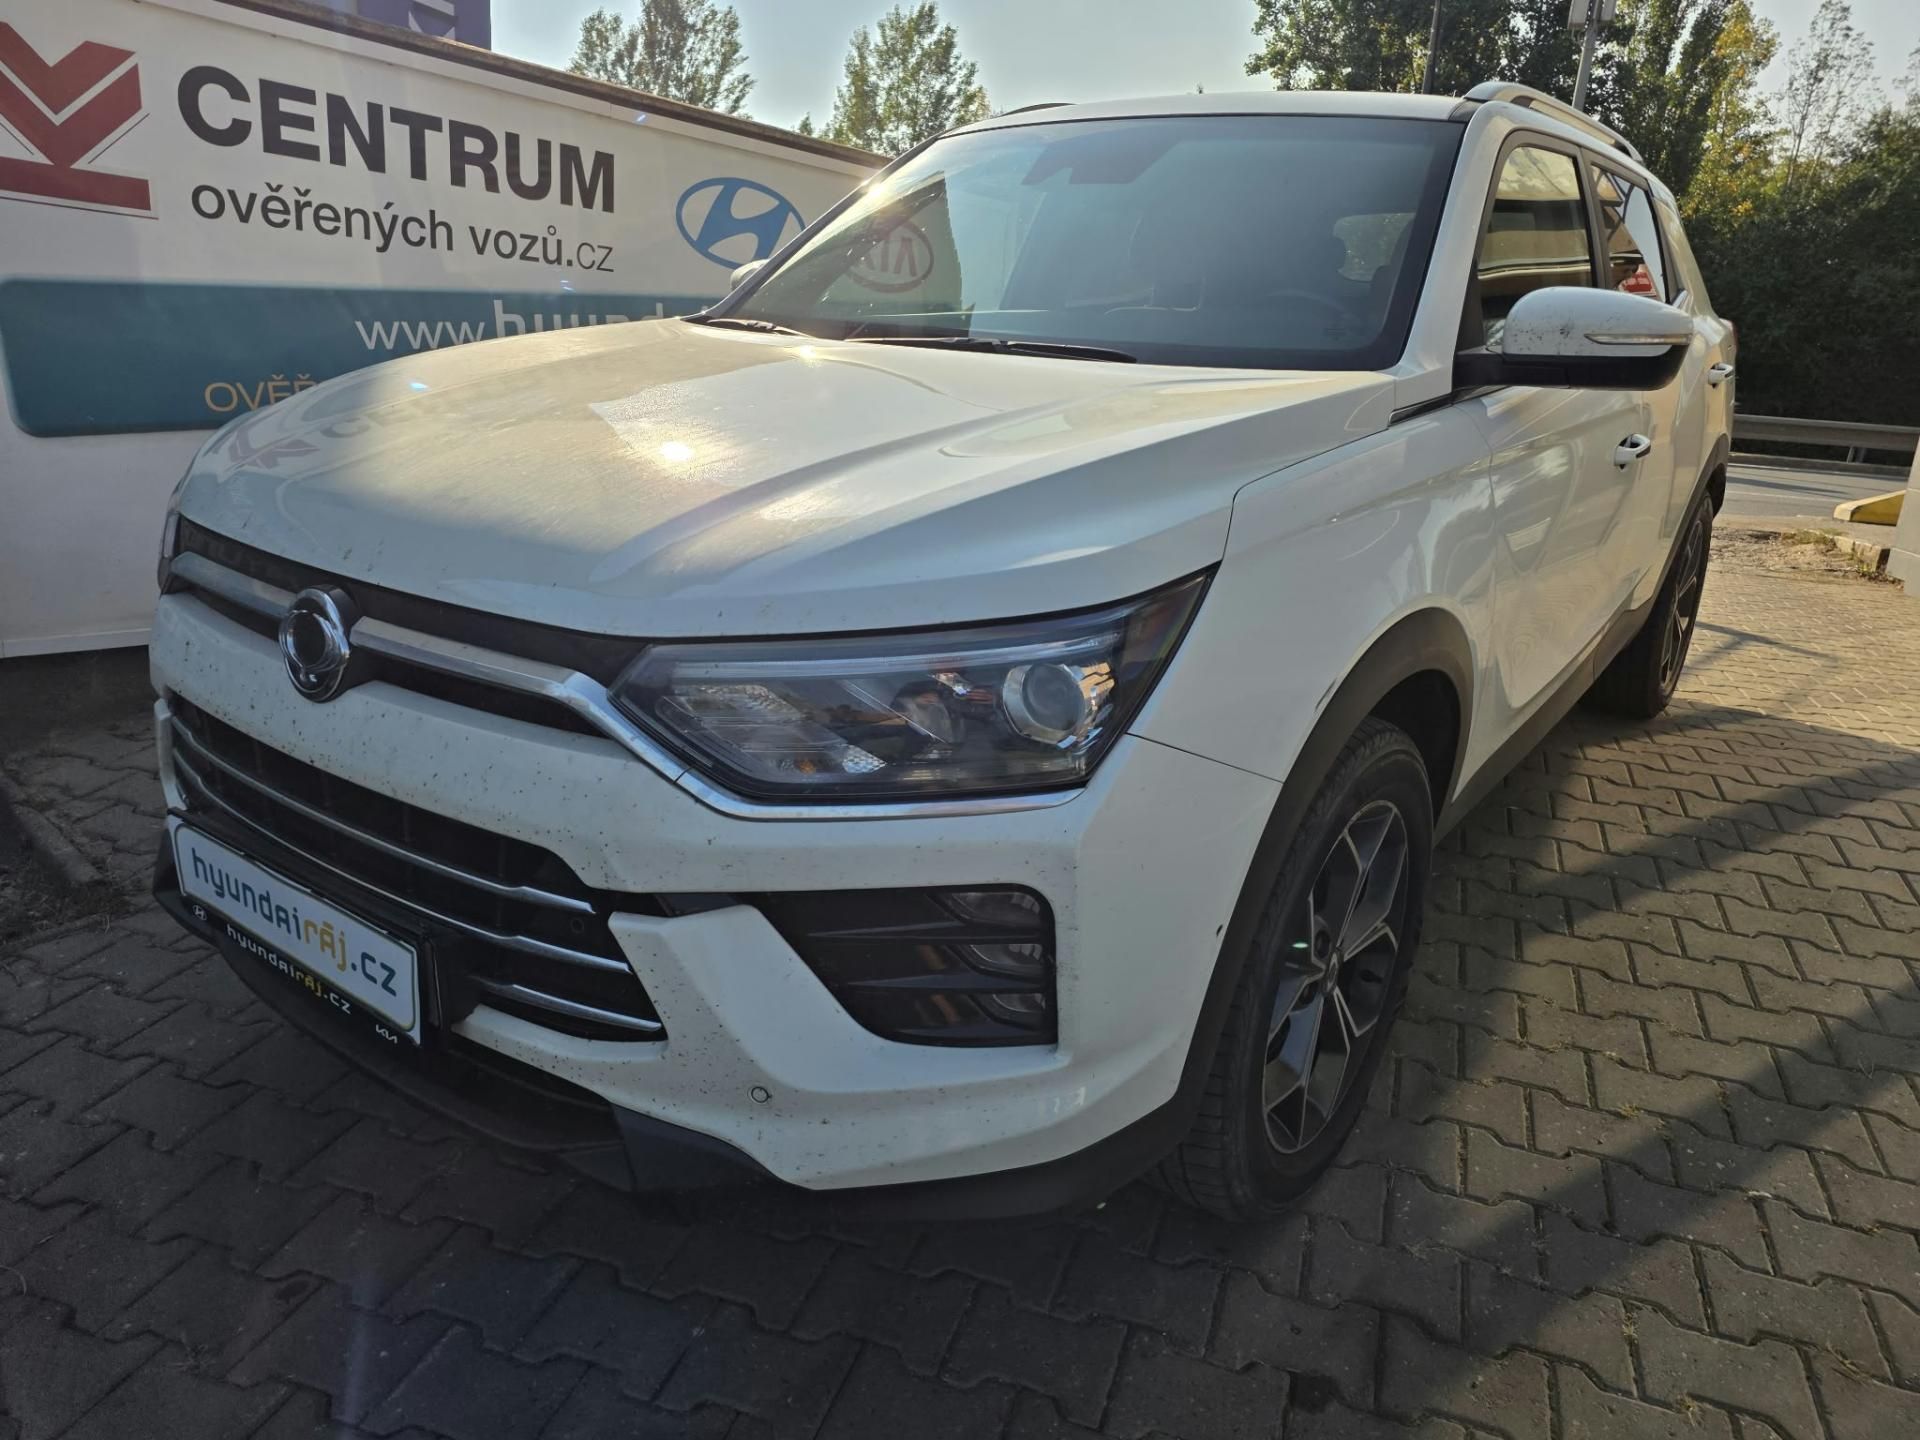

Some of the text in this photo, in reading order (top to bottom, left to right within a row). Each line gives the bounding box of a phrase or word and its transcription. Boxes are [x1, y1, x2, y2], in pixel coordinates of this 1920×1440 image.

[177, 65, 615, 214] CENTRUM
[191, 182, 615, 272] ověřených vozů.cz
